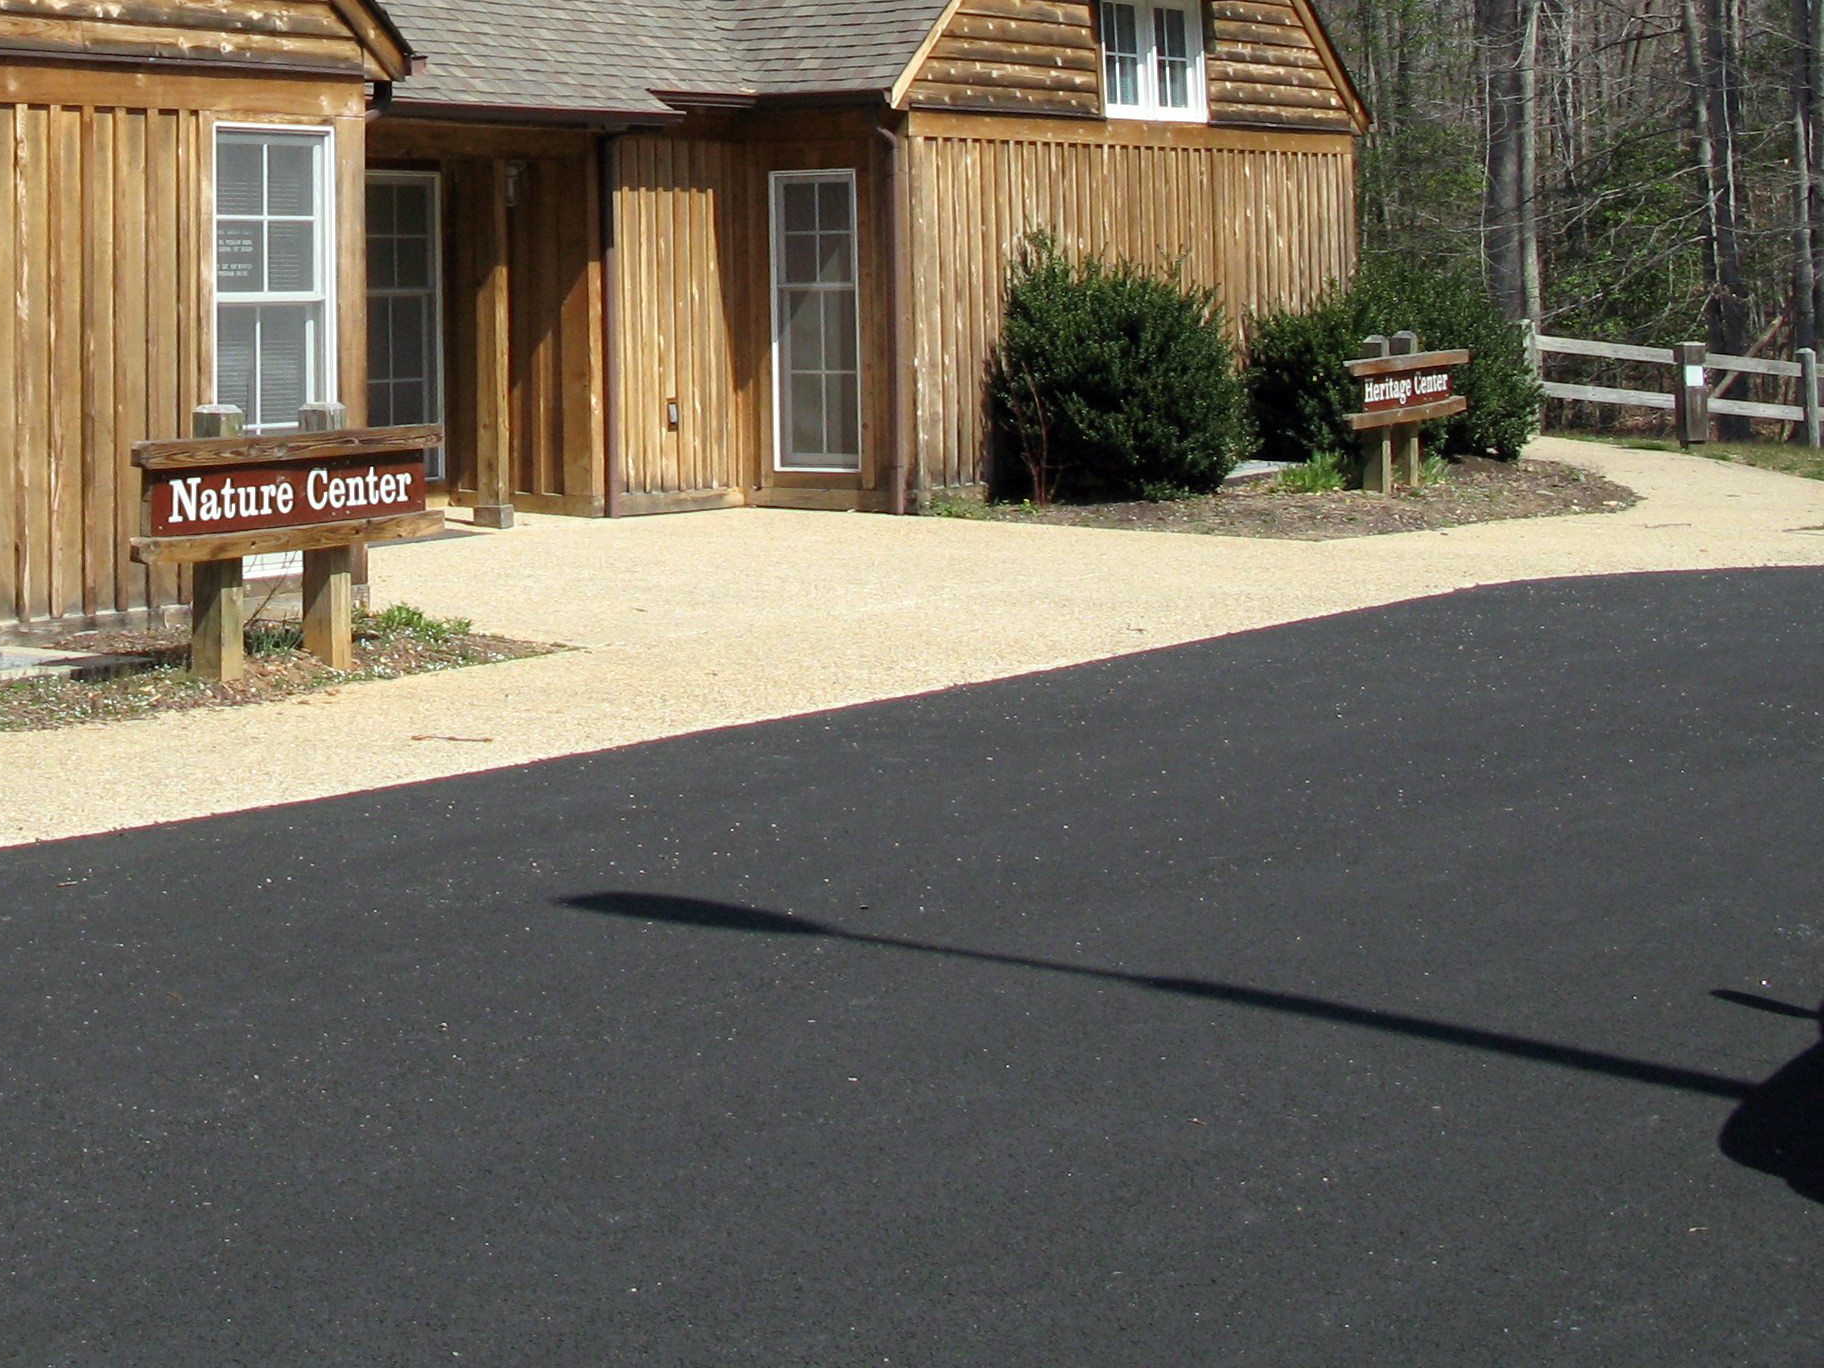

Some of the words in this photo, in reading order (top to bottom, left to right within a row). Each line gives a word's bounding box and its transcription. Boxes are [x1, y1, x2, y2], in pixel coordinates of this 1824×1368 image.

[1365, 378, 1412, 404] Heritage
[1414, 372, 1449, 394] Center
[168, 477, 293, 523] Nature
[306, 466, 412, 510] Center
